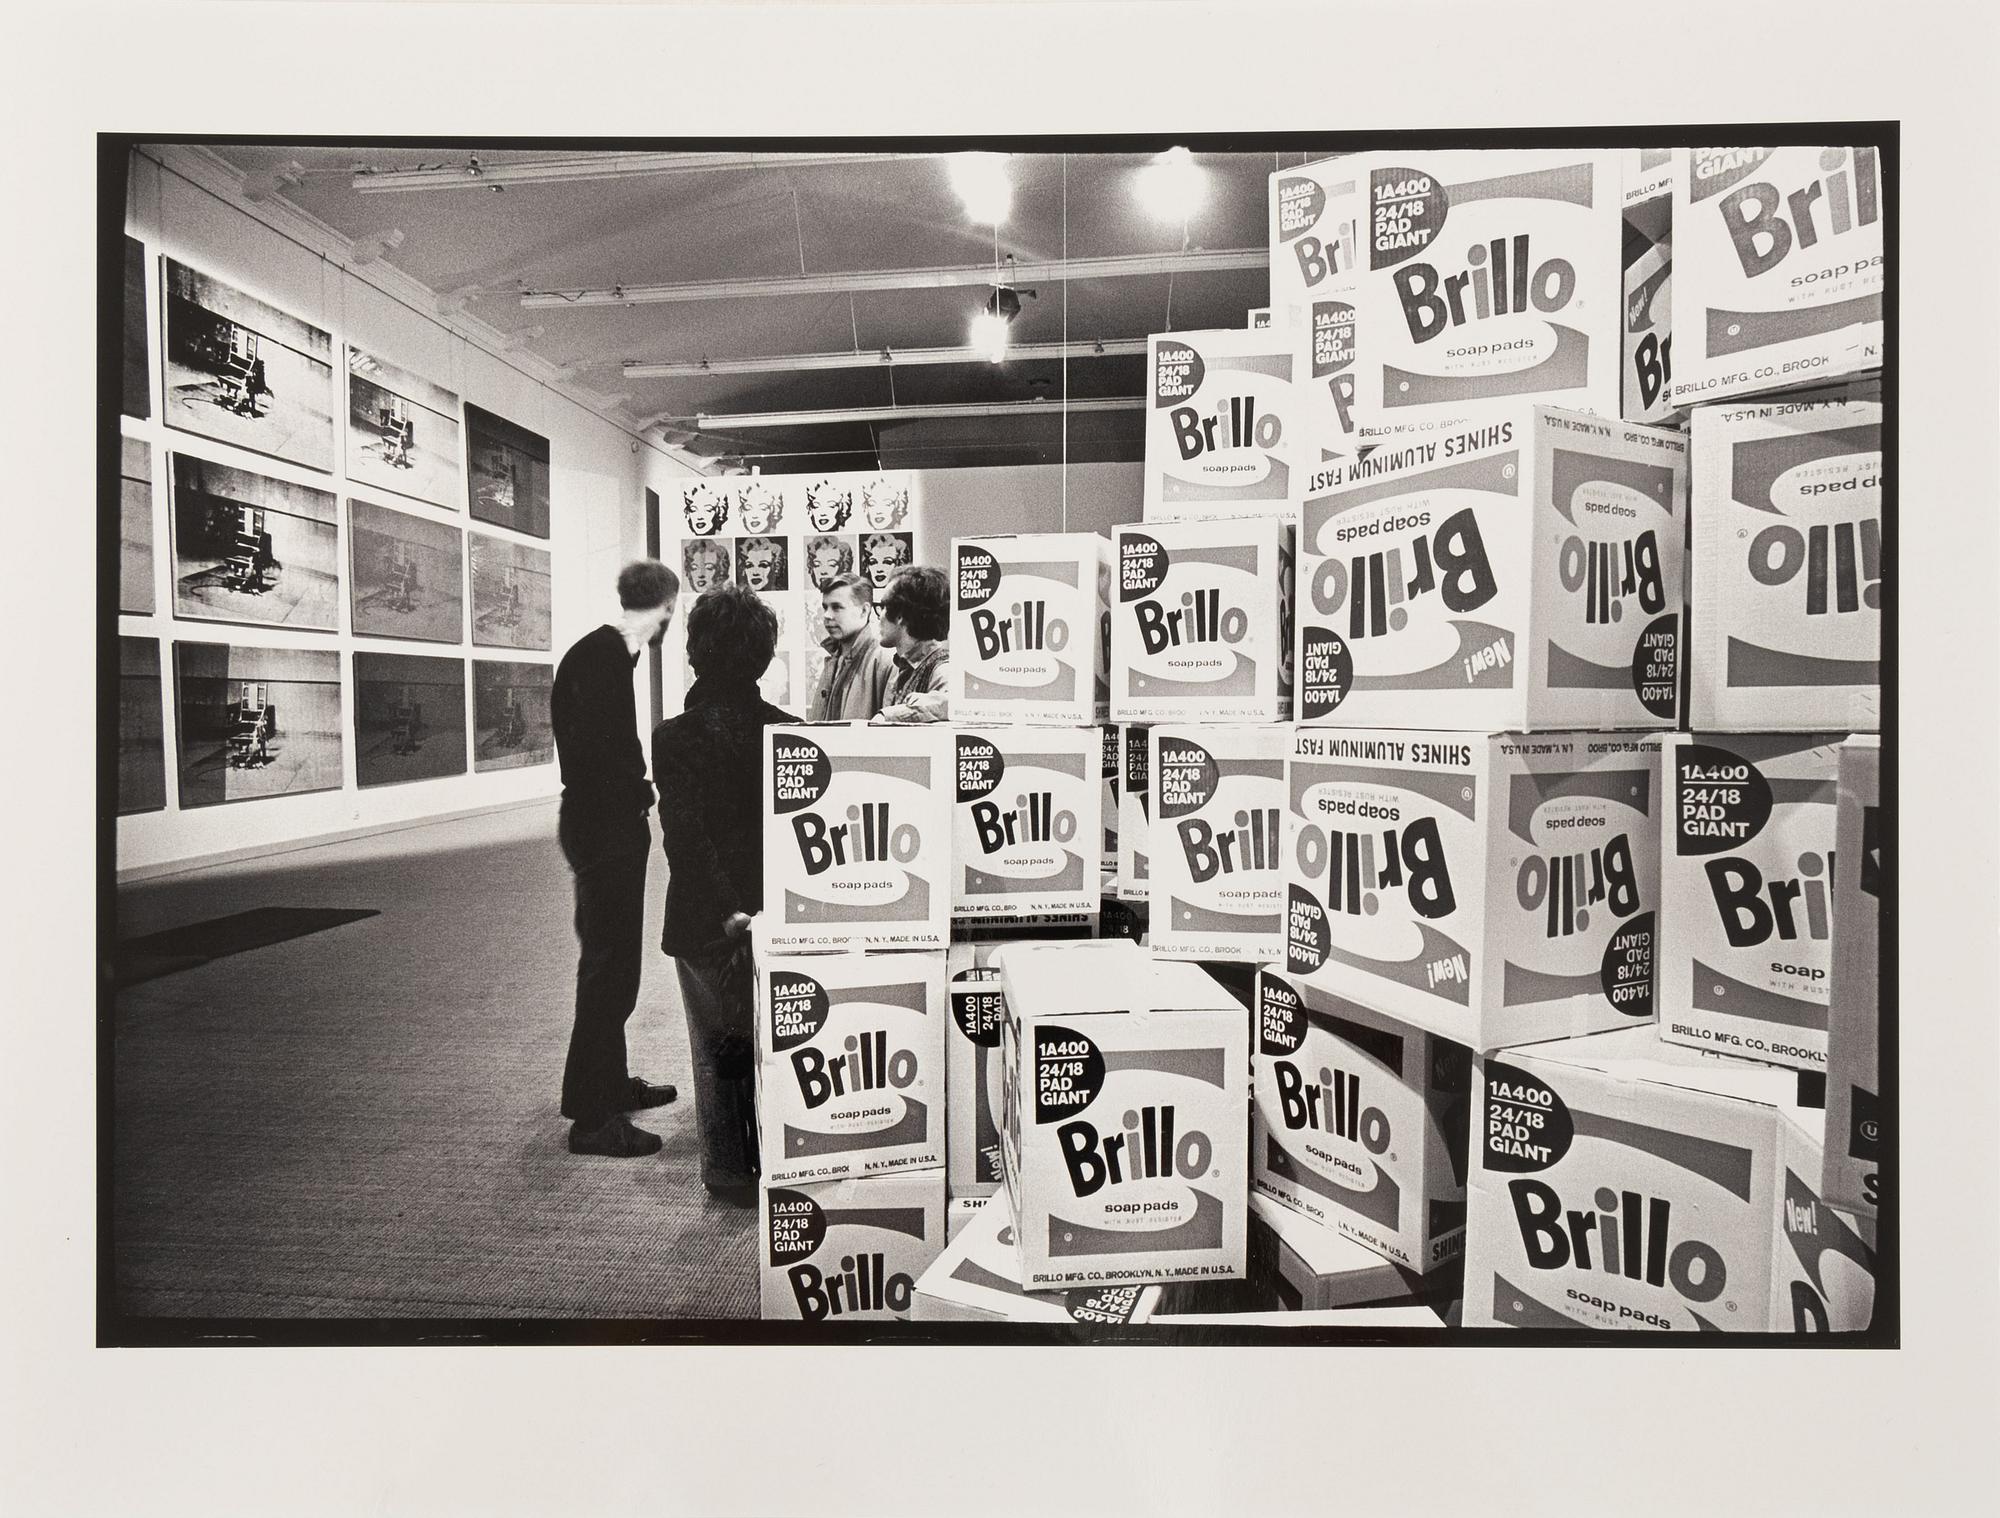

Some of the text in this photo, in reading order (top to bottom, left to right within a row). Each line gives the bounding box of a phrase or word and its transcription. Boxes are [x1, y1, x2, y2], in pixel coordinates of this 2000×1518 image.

[1374, 178, 1431, 199] 1A400
[1375, 201, 1424, 218] 24/18
[1375, 218, 1412, 234] PAD
[1375, 229, 1431, 250] GIANT
[1293, 219, 1356, 287] Bri
[1790, 265, 1849, 288] soap
[1393, 234, 1576, 344] Brillo
[1315, 308, 1355, 326] 1A400
[1315, 326, 1352, 340] 24/18
[1315, 340, 1342, 355] PAD
[1446, 338, 1534, 359] soap pads
[1158, 350, 1194, 362] 1A400
[1315, 348, 1355, 364] GIANT
[1158, 365, 1189, 376] 24/18
[1158, 375, 1182, 386] PAD
[1675, 378, 1717, 396] BRILLO
[1158, 384, 1194, 396] GIANT
[1170, 396, 1282, 460] Brillo
[1309, 422, 1513, 492] SHINES ALUMINUM FAST
[1202, 464, 1256, 474] soap pads
[1800, 479, 1856, 496] pads
[1585, 502, 1636, 517] soap pads
[1383, 512, 1431, 533] soap
[1336, 519, 1379, 542] pads
[1122, 542, 1157, 554] 1A400
[960, 555, 991, 566] 1A400
[1123, 558, 1154, 568] 24/18
[960, 570, 988, 580] 24/18
[1122, 569, 1146, 579] PAD
[1312, 508, 1498, 639] Brillo
[1559, 530, 1666, 624] Brillo
[960, 580, 980, 590] PAD
[1123, 578, 1158, 590] GIANT
[960, 589, 991, 598] GIANT
[1134, 589, 1248, 655] Brillo
[970, 601, 1069, 660] Brillo
[1644, 633, 1675, 648] GIANT
[1306, 642, 1341, 658] GIANT
[1655, 648, 1674, 661] PAD
[1168, 659, 1222, 668] soap pads
[1308, 656, 1329, 670] PAD
[1465, 638, 1511, 684] New!
[1023, 666, 1046, 674] pads
[1306, 668, 1337, 684] 24/18
[1647, 664, 1674, 678] 24/18
[1305, 689, 1341, 703] 1A400
[1642, 686, 1674, 700] 1A400
[776, 747, 818, 759] 1A400
[959, 746, 993, 756] 1A400
[1162, 750, 1205, 762] 1A400
[1296, 738, 1470, 766] SHINES ALUMINUM FAST
[777, 764, 813, 776] 24/18
[960, 761, 990, 770] 24/18
[1682, 765, 1748, 780] 1A400
[778, 776, 804, 787] PAD
[960, 770, 982, 780] PAD
[1163, 768, 1200, 780] 24/18
[778, 786, 818, 799] GIANT
[960, 780, 994, 790] GIANT
[1163, 780, 1191, 792] PAD
[1163, 792, 1206, 804] GIANT
[1683, 789, 1741, 804] 24/18
[1318, 798, 1400, 821] soap pads
[1684, 806, 1725, 820] PAD
[970, 792, 1076, 854] Brillo
[1546, 817, 1606, 830] soap pads
[1684, 822, 1749, 837] GIANT
[791, 802, 920, 876] Brillo
[1177, 808, 1280, 882] Brill
[1004, 858, 1054, 866] soap pads
[1296, 817, 1456, 920] Brillo
[832, 880, 892, 891] soap pads
[1516, 834, 1640, 938] Brillo
[1219, 890, 1250, 900] soap
[1293, 900, 1321, 920] GIANT
[1290, 914, 1311, 929] PAD
[1290, 926, 1318, 946] 24/18
[1614, 932, 1650, 951] GIANT
[1290, 946, 1320, 966] 1A400
[1626, 948, 1650, 962] PAD
[1428, 955, 1468, 988] New!
[1618, 962, 1650, 980] 24/18
[1771, 962, 1825, 981] soap
[773, 983, 815, 996] 1A400
[1263, 986, 1296, 1005] 1A400
[1613, 986, 1650, 1004] 1A400
[775, 1000, 811, 1012] 24/18
[982, 996, 994, 1031] 24/18
[1264, 1005, 1292, 1022] 24/18
[776, 1012, 802, 1025] PAD
[966, 996, 976, 1034] 1A400
[776, 1022, 816, 1037] GIANT
[1264, 1018, 1285, 1032] PAD
[1264, 1030, 1297, 1048] GIANT
[1672, 1024, 1711, 1040] BRILLO
[1715, 1032, 1742, 1046] MFG.
[1039, 1042, 1088, 1056] 1A400
[790, 1030, 918, 1110] Brillo
[1040, 1062, 1083, 1077] 24/18
[1040, 1078, 1072, 1092] PAD
[1040, 1091, 1090, 1106] GIANT
[1490, 1081, 1552, 1105] 1A400
[830, 1106, 891, 1121] soap pads
[1274, 1060, 1390, 1155] Brillo
[1490, 1104, 1544, 1129] 24/18
[1490, 1122, 1530, 1140] PAD
[1057, 1106, 1212, 1198] Brillo
[1490, 1140, 1552, 1163] GIANT
[1305, 1144, 1333, 1164] soap
[1334, 1156, 1362, 1175] pads
[772, 1202, 812, 1213] 1A400
[1104, 1201, 1178, 1215] soap pads
[774, 1219, 808, 1228] 24/18
[1786, 1198, 1818, 1236] New!
[774, 1230, 800, 1240] PAD
[1508, 1178, 1726, 1303] Brillo
[774, 1241, 814, 1252] GIANT
[1032, 1274, 1062, 1283] BRILLO
[1175, 1267, 1198, 1276] MADE
[1201, 1266, 1209, 1274] IN
[788, 1253, 915, 1321] Brillo
[1566, 1288, 1671, 1330] soap pads
